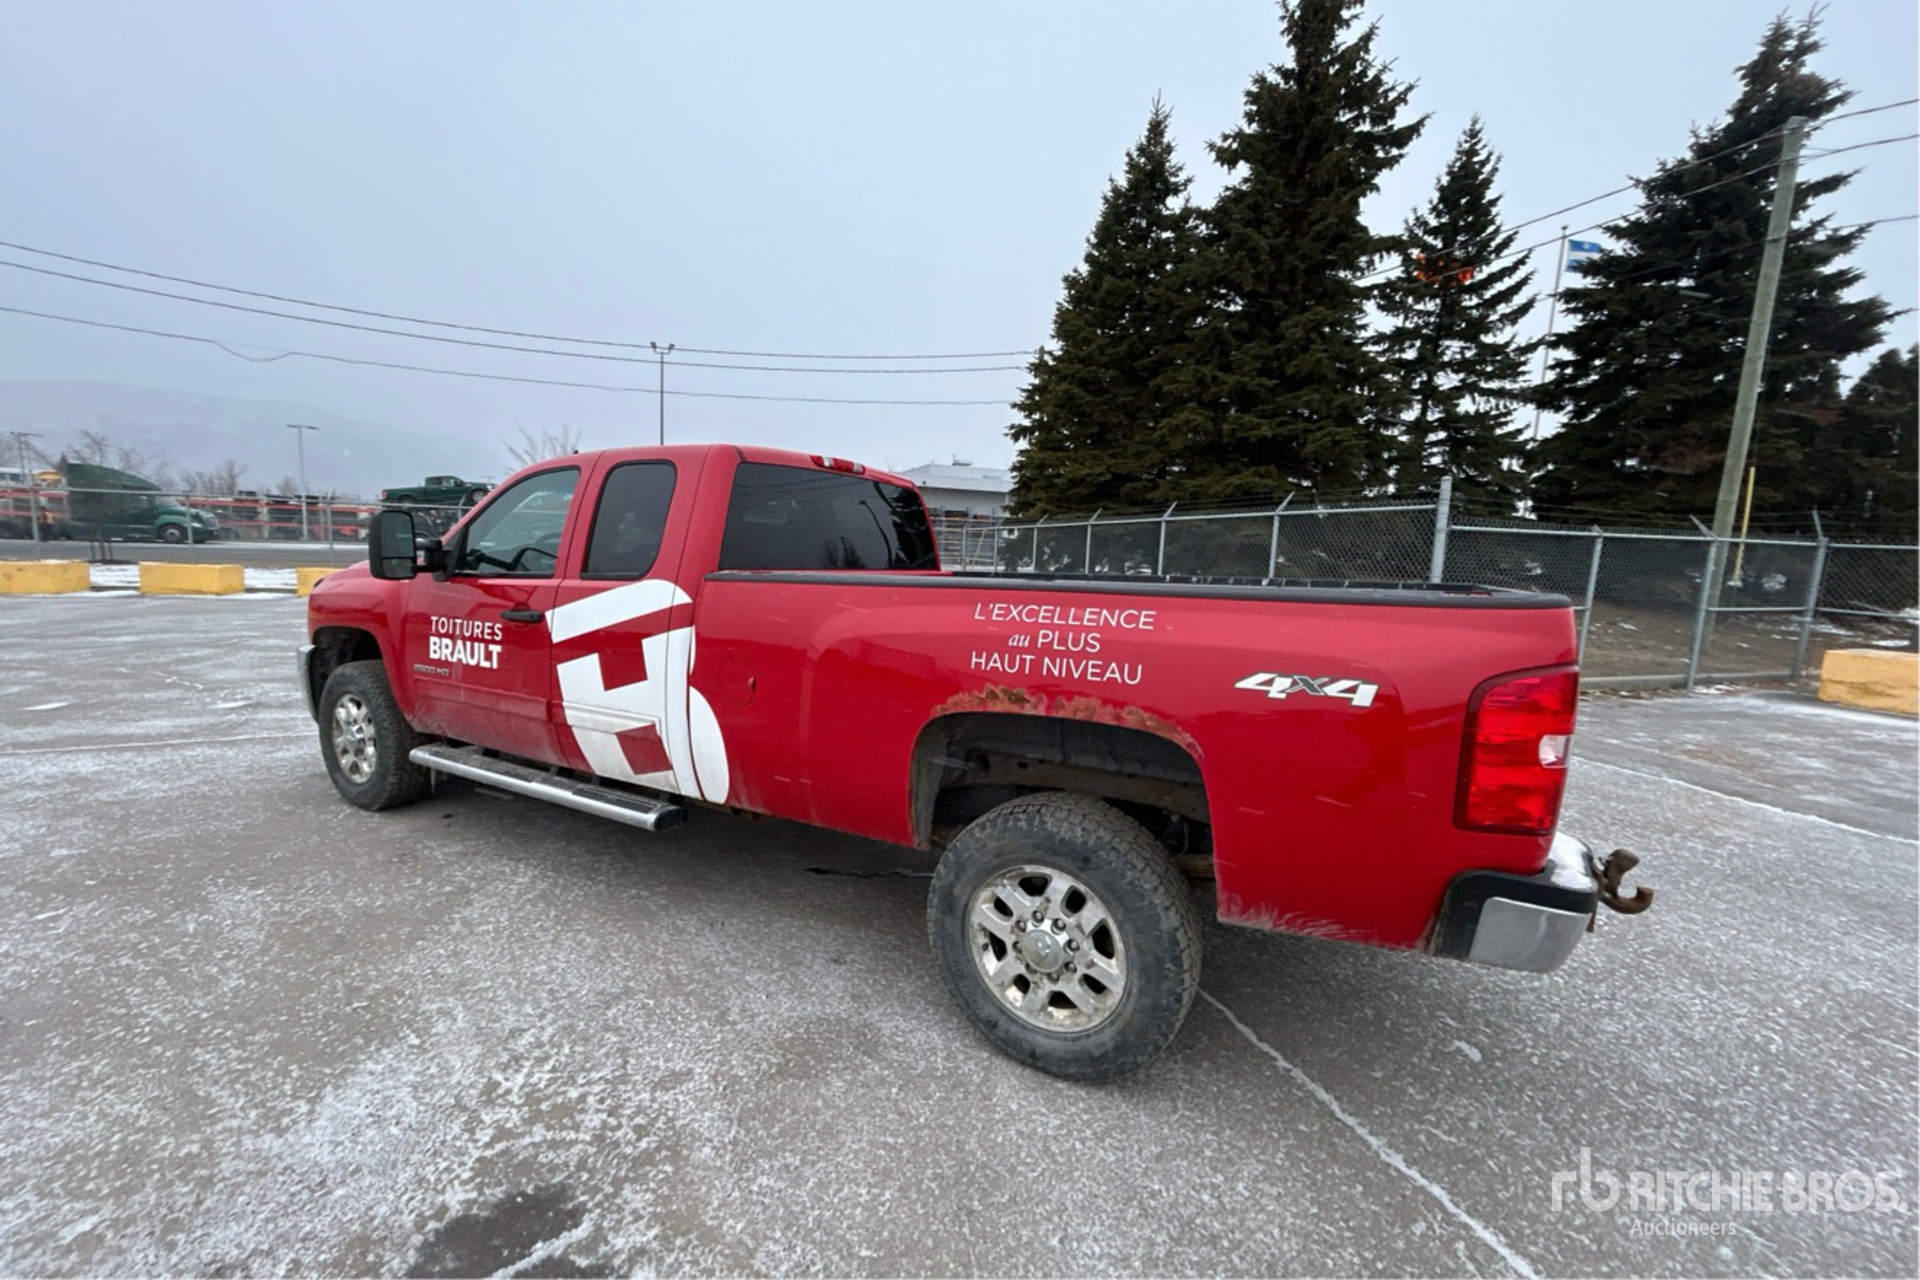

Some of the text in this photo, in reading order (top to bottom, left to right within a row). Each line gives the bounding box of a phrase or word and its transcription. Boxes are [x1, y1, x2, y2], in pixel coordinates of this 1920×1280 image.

[430, 616, 502, 641] TOITURES
[974, 603, 1156, 630] L'EXCELLENCE
[429, 635, 502, 669] BRAULT
[1008, 630, 1101, 652] au PLUS
[971, 651, 1142, 685] HAUT NIVEAU
